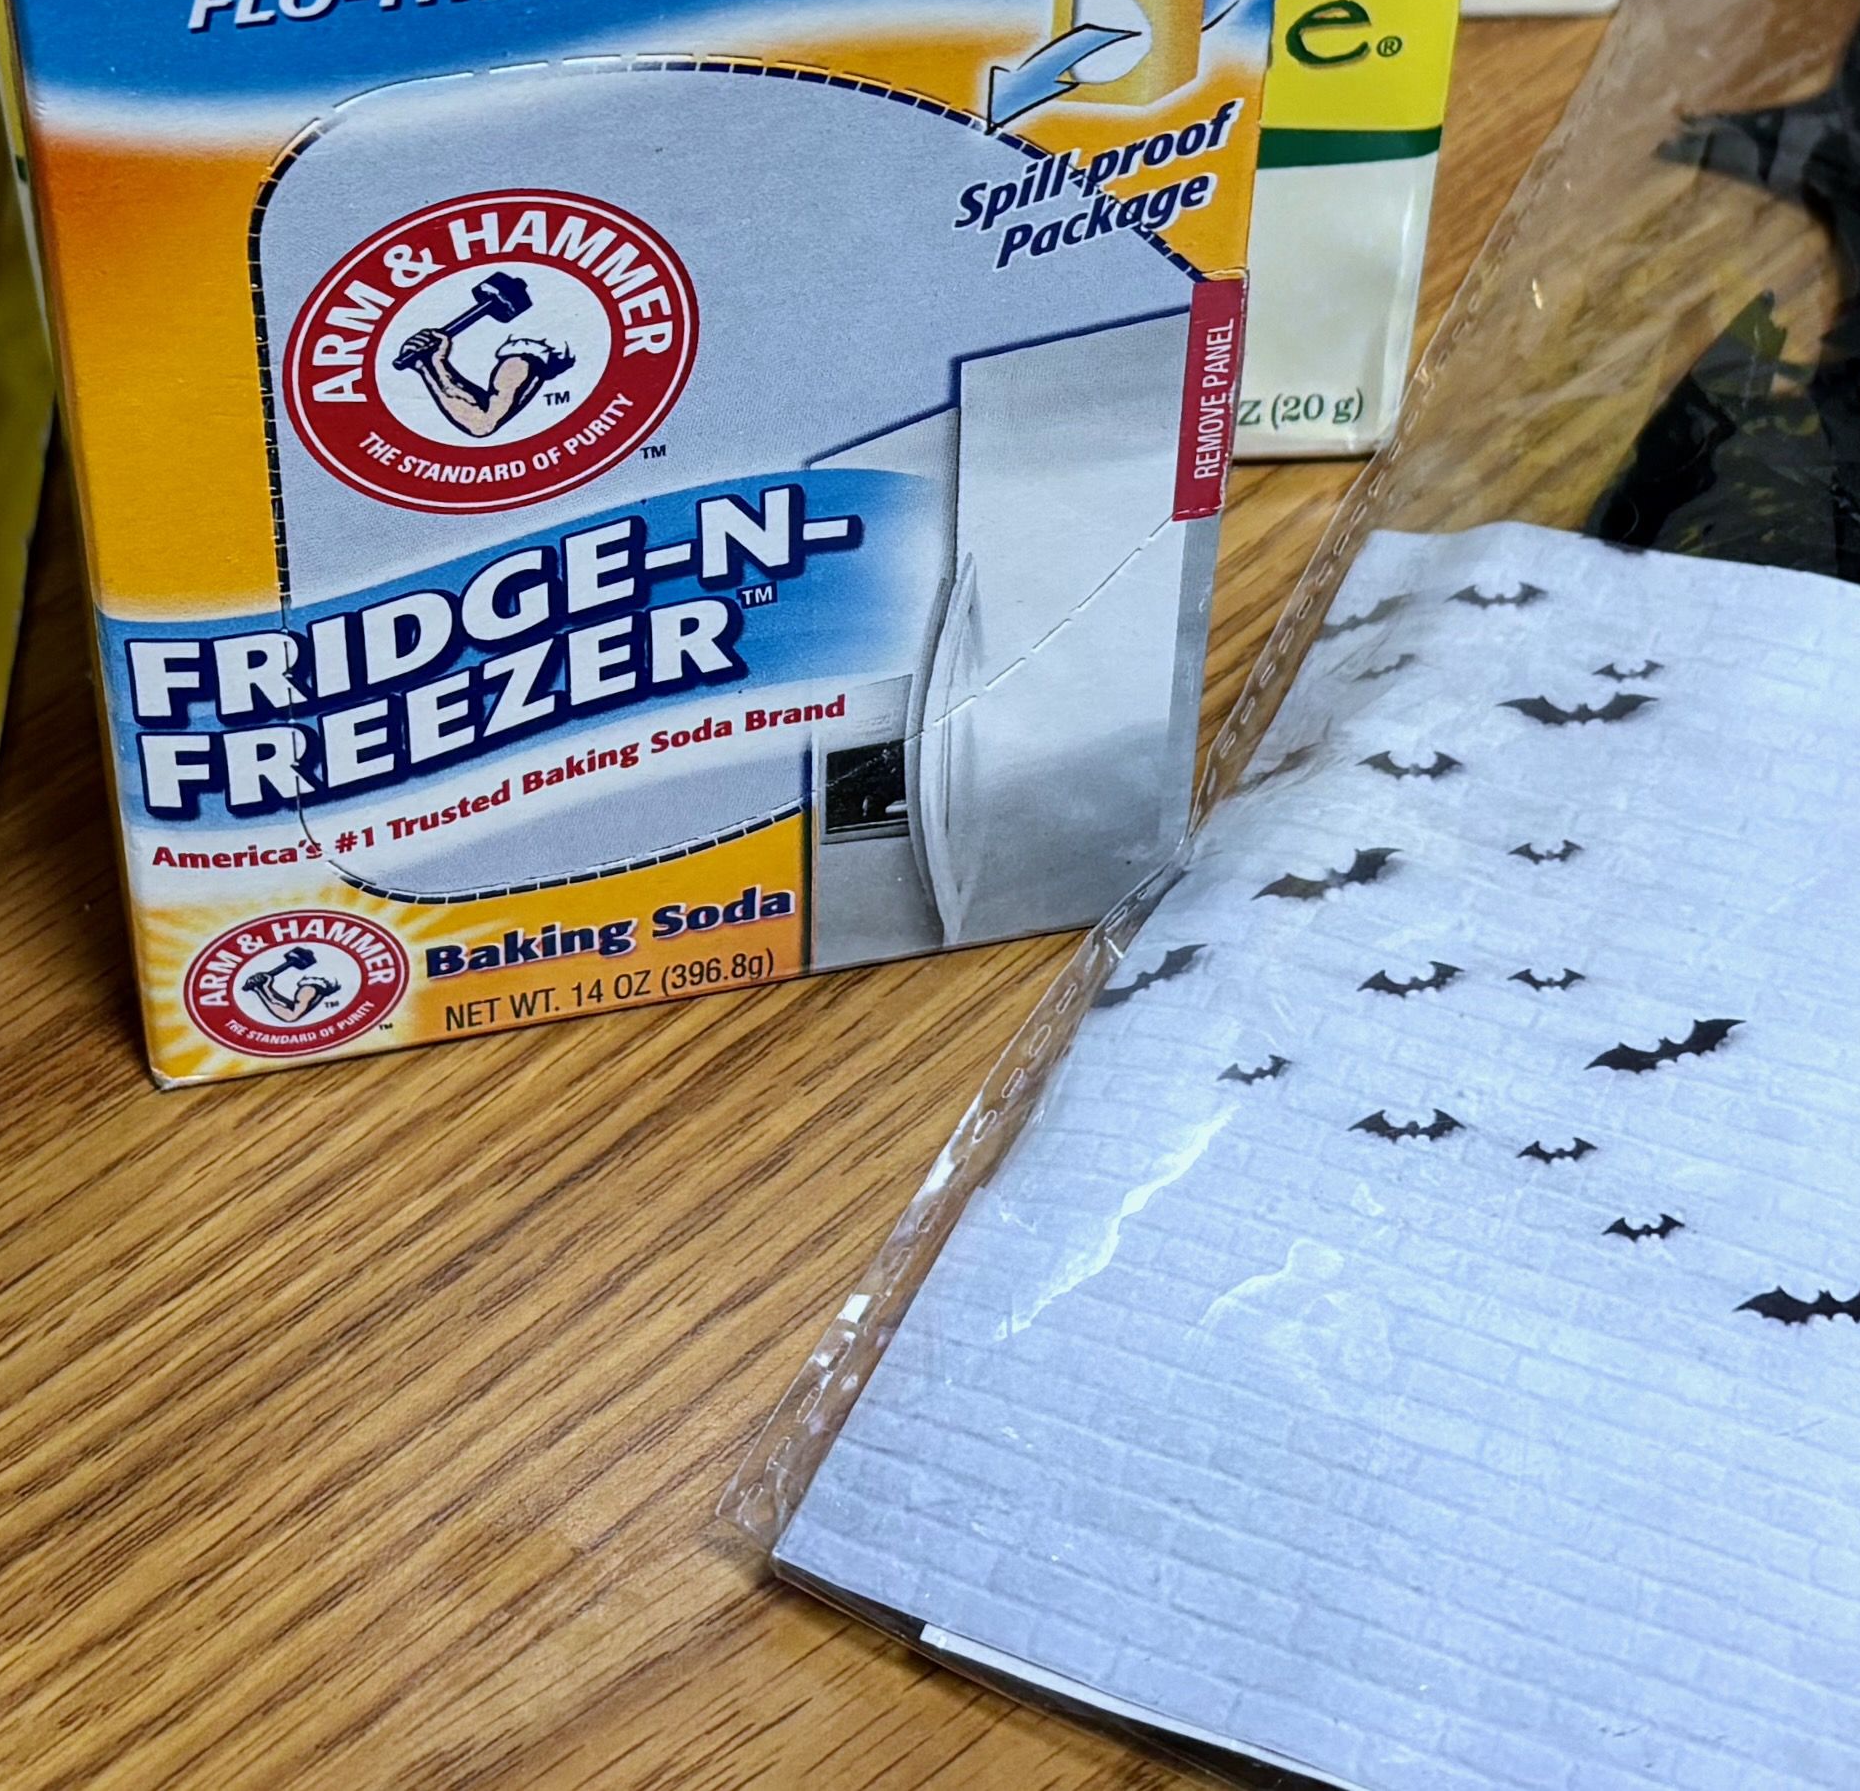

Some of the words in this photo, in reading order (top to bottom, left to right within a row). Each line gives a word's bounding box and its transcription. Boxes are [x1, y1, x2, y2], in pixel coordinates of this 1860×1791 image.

[954, 100, 1237, 230] Spill-proof
[994, 173, 1211, 269] Package
[313, 279, 396, 404] ARM
[383, 243, 448, 289] &
[448, 210, 674, 359] HAMMER
[1202, 318, 1234, 388] PANEL
[358, 431, 400, 467] THE
[400, 454, 527, 485] STANDARD
[531, 447, 562, 472] OF
[560, 392, 634, 457] PURITY
[1193, 392, 1227, 480] REMOVE
[1271, 392, 1325, 431] (20
[1333, 387, 1365, 425] g)
[129, 485, 851, 718] FRIDGE-N-
[139, 599, 736, 809] FREEZER
[151, 839, 323, 869] America's
[334, 825, 376, 854] #1
[385, 779, 512, 840] Trusted
[521, 741, 640, 795] Baking
[650, 716, 734, 754] Soda
[744, 694, 846, 733] Brand
[199, 948, 242, 1007] ARM
[236, 933, 269, 955] &
[270, 918, 397, 986] HAMMER
[425, 918, 638, 980] Baking
[651, 885, 796, 940] Soda
[224, 1018, 247, 1037] THE
[246, 1030, 317, 1045] STANDARD
[320, 1026, 337, 1039] OF
[339, 1000, 375, 1031] PURITY
[444, 997, 501, 1032] NET
[509, 987, 561, 1019] WT.
[571, 978, 604, 1007] 14
[613, 969, 652, 1001] OZ
[660, 947, 775, 998] (396.8g)
